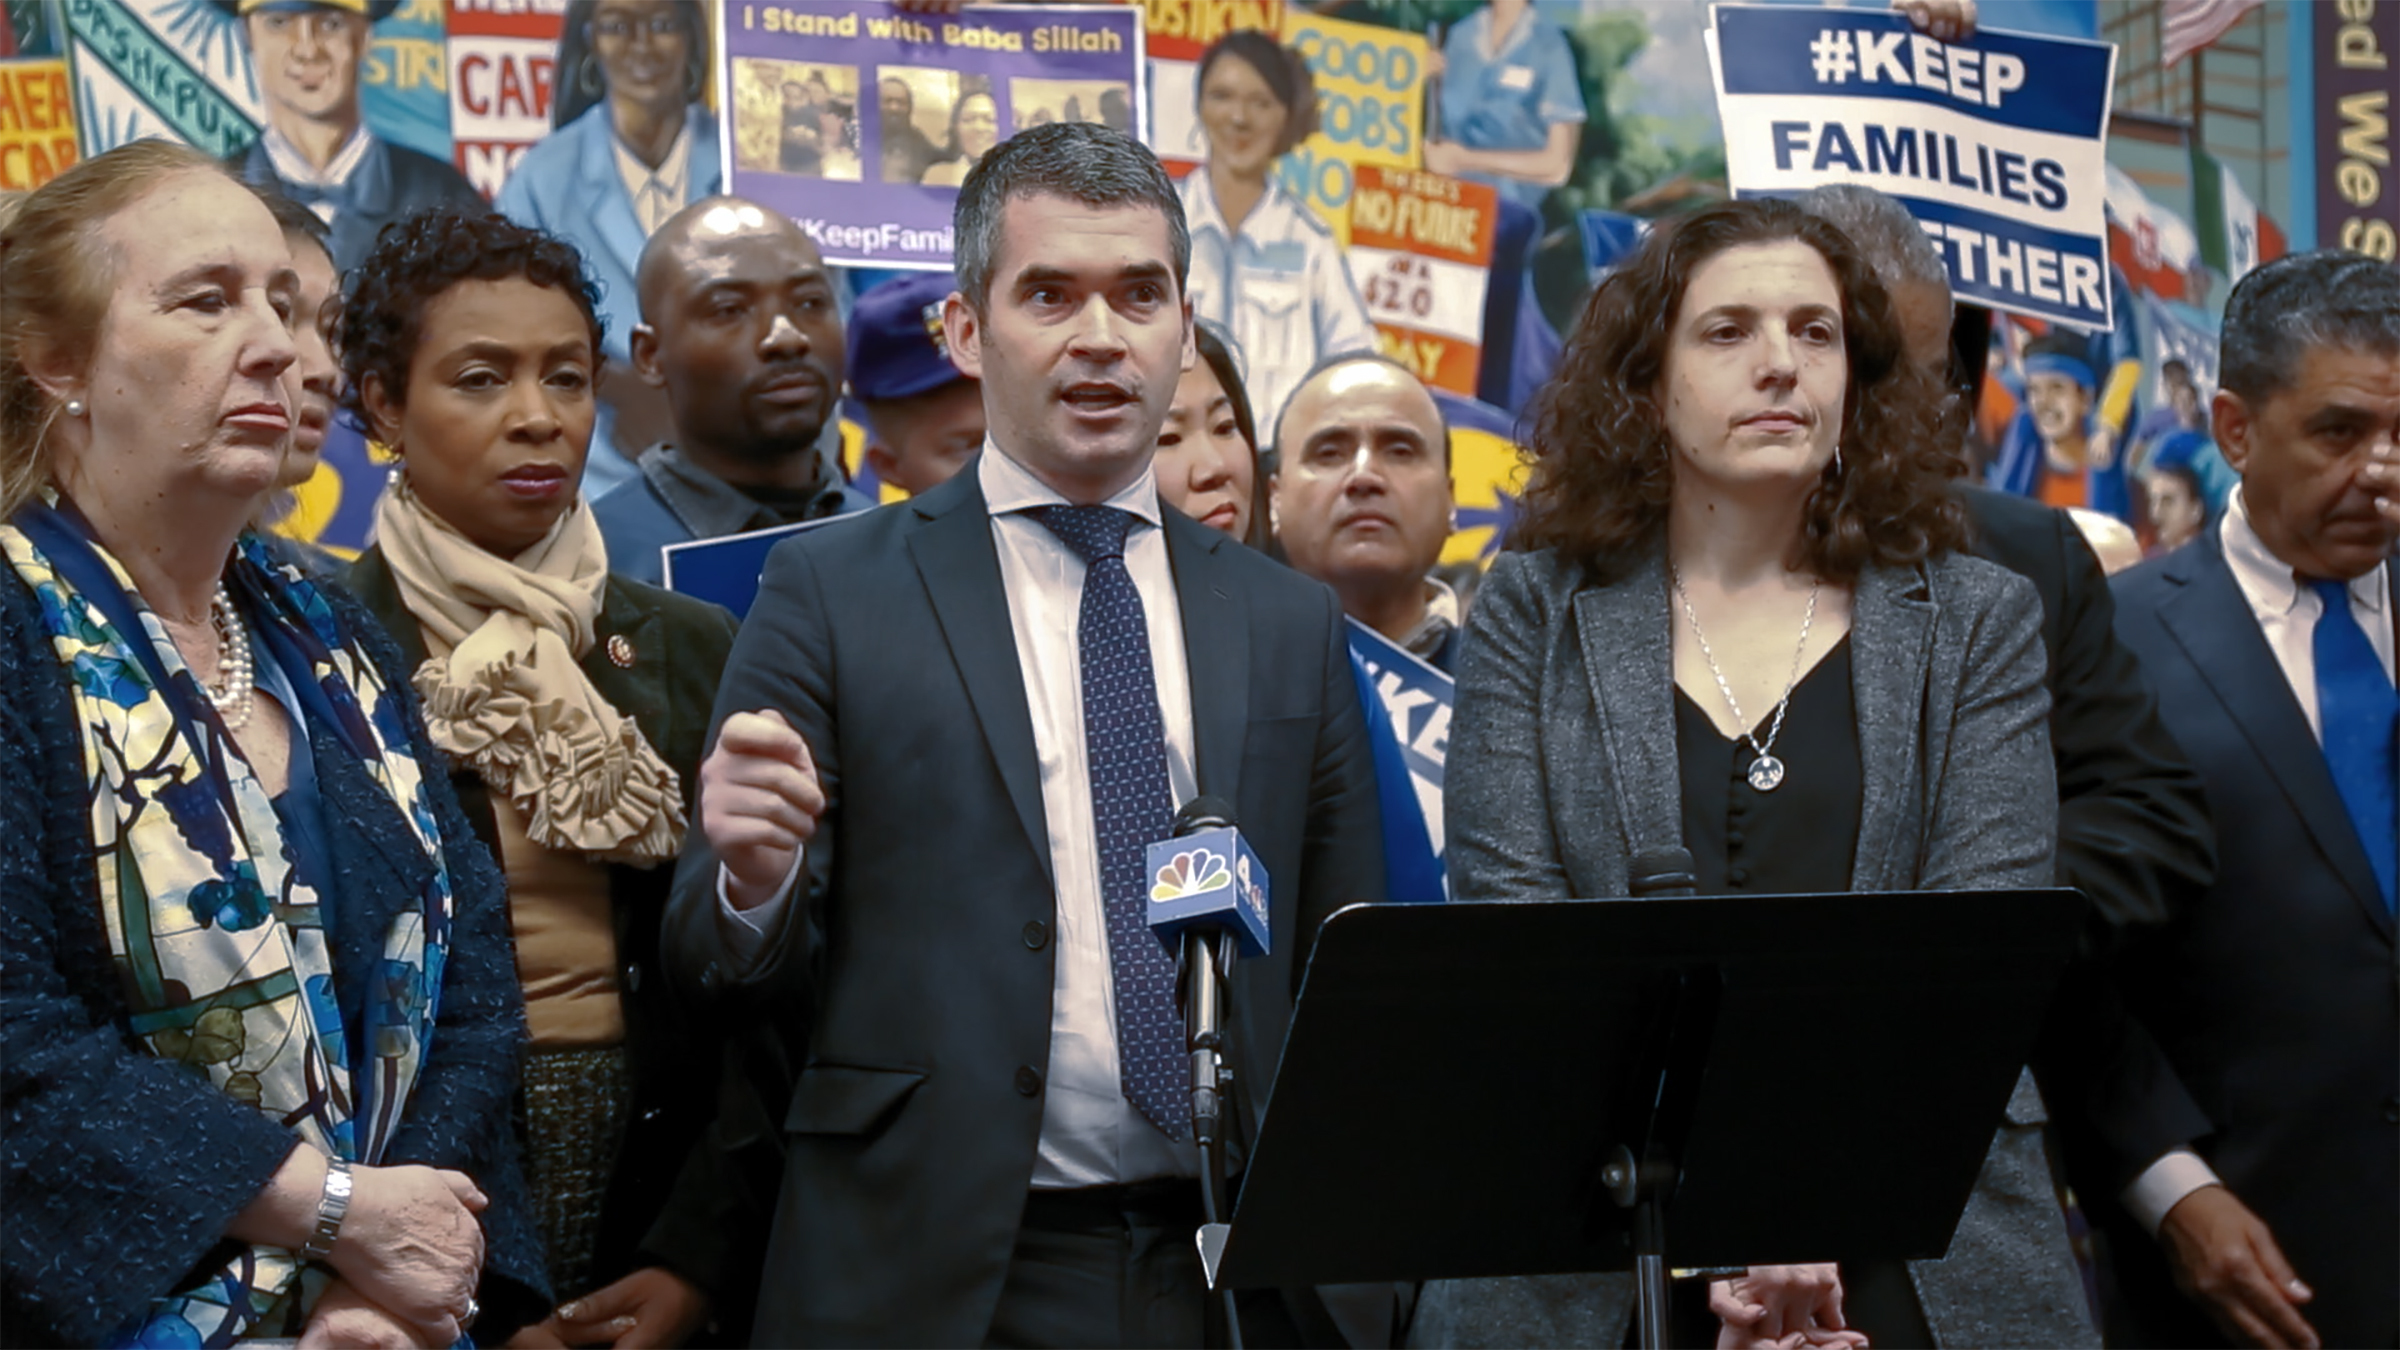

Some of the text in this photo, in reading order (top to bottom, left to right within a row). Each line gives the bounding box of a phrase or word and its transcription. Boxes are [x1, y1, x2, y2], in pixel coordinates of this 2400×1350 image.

[743, 4, 1123, 53] I Stand with Baba Sillah
[1294, 28, 1418, 93] GOOD
[1809, 28, 2028, 109] #KEEP
[463, 143, 529, 199] N
[1278, 148, 1355, 209] NO
[1770, 120, 2069, 213] FAMILIES
[2336, 90, 2391, 208] We
[1353, 187, 1394, 234] NO
[1363, 660, 1453, 768] KE
